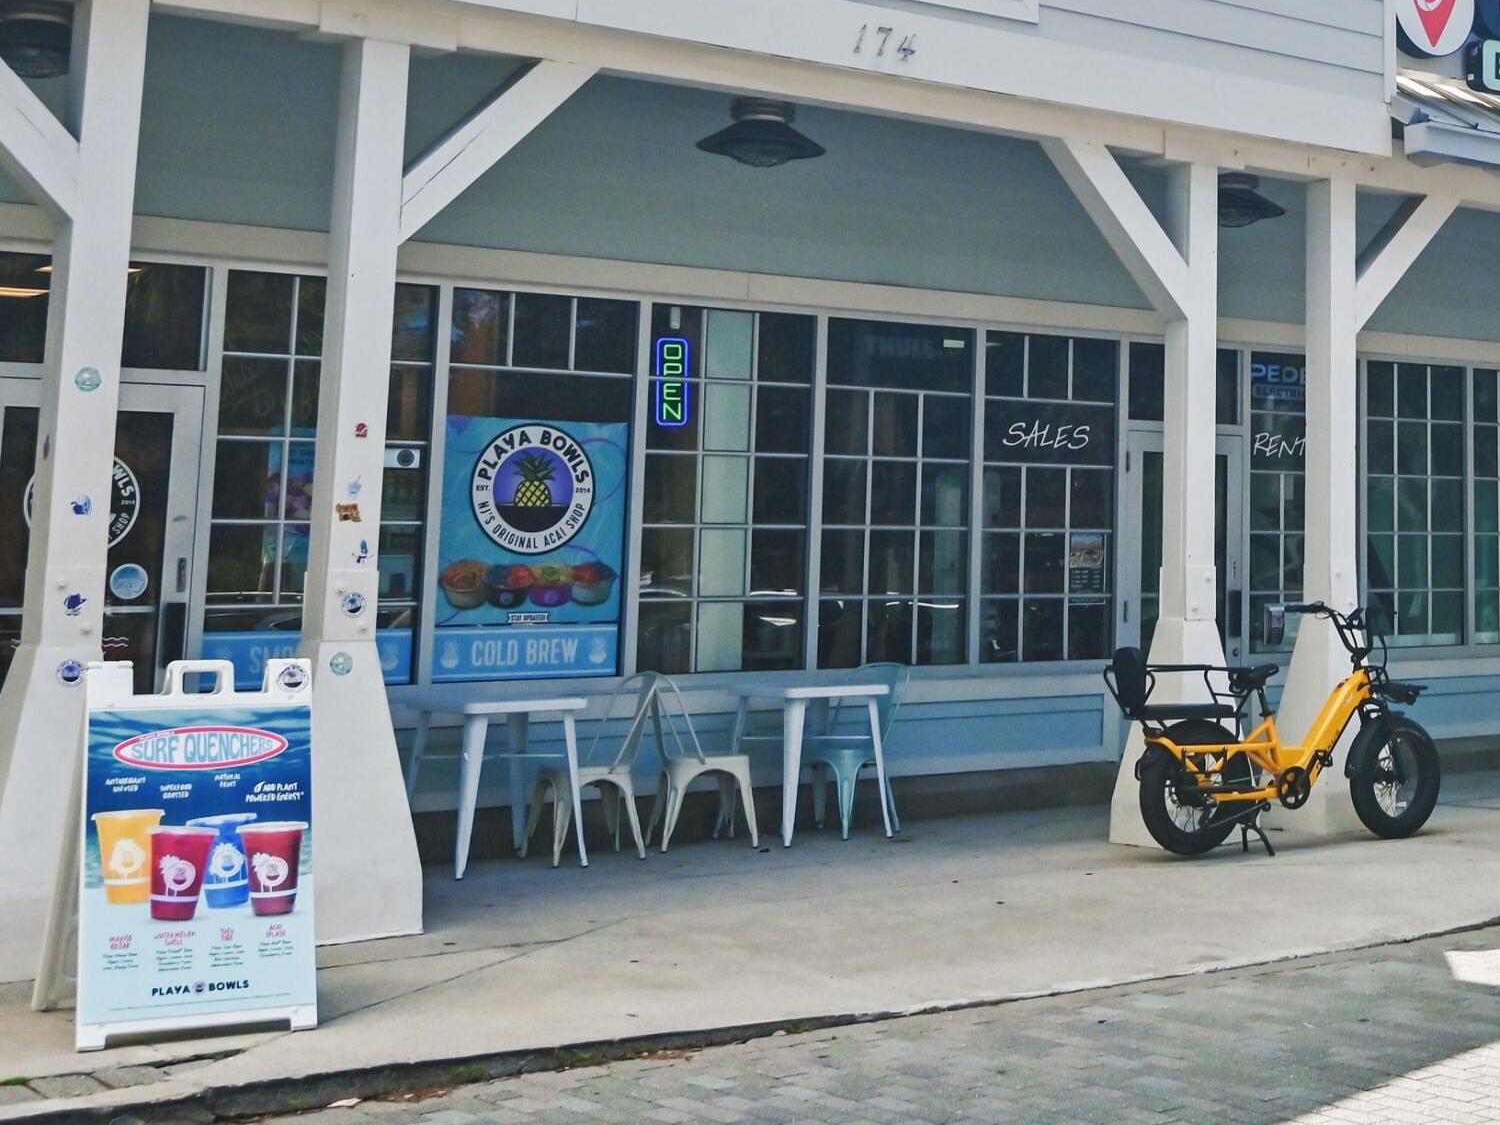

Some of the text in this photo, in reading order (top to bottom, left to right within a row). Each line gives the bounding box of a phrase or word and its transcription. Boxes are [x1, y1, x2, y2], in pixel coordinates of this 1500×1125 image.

[853, 23, 916, 62] 174
[663, 344, 682, 421] OPEN
[1251, 363, 1306, 385] PED
[1002, 419, 1090, 450] SALES
[1253, 432, 1306, 458] RENT
[477, 429, 589, 483] PLAYA BOWLS
[113, 464, 135, 497] WLS
[111, 512, 131, 534] SHOP
[478, 501, 585, 549] NJ'S ORIGINAL ACAI SHOP
[471, 638, 578, 667] COLD BREW
[131, 732, 273, 763] SURF QUENCHERS
[151, 979, 250, 996] PLAYA BOWLS
